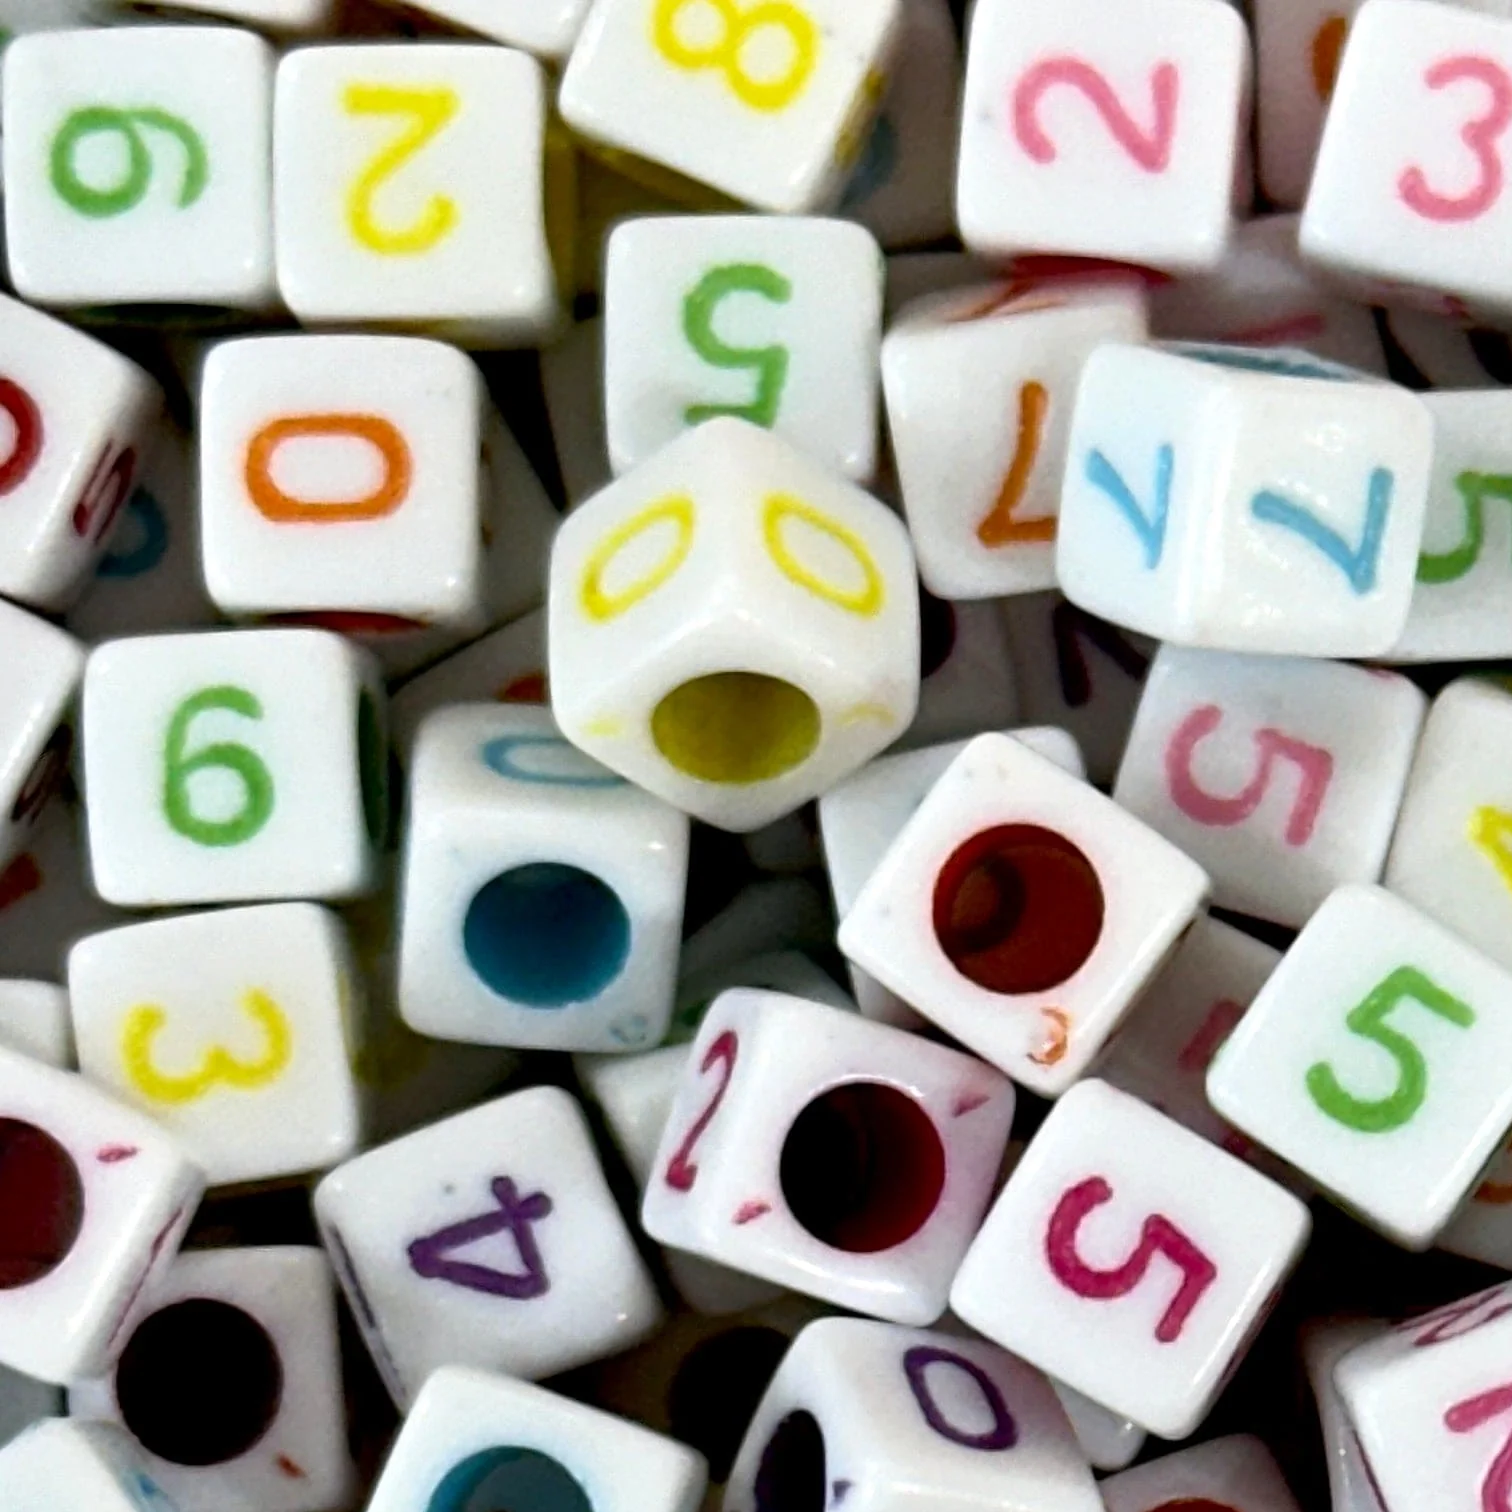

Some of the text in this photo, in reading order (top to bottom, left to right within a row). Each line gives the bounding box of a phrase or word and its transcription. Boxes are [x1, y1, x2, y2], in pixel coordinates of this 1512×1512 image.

[650, 0, 815, 112] 8
[1015, 60, 1176, 170] 2
[339, 81, 461, 257] 2
[1402, 58, 1512, 219] 3
[682, 263, 789, 425] 5
[244, 414, 410, 522] 0
[1084, 442, 1175, 570] 7
[1252, 466, 1394, 595] 7
[578, 494, 695, 623] 0
[759, 492, 886, 619] 0
[163, 686, 272, 845] 6
[1170, 711, 1330, 844] 5
[118, 988, 293, 1111] 3
[1307, 967, 1473, 1132] 5
[409, 1176, 552, 1298] 4
[1046, 1179, 1214, 1340] 5
[906, 1349, 1015, 1448] 0
